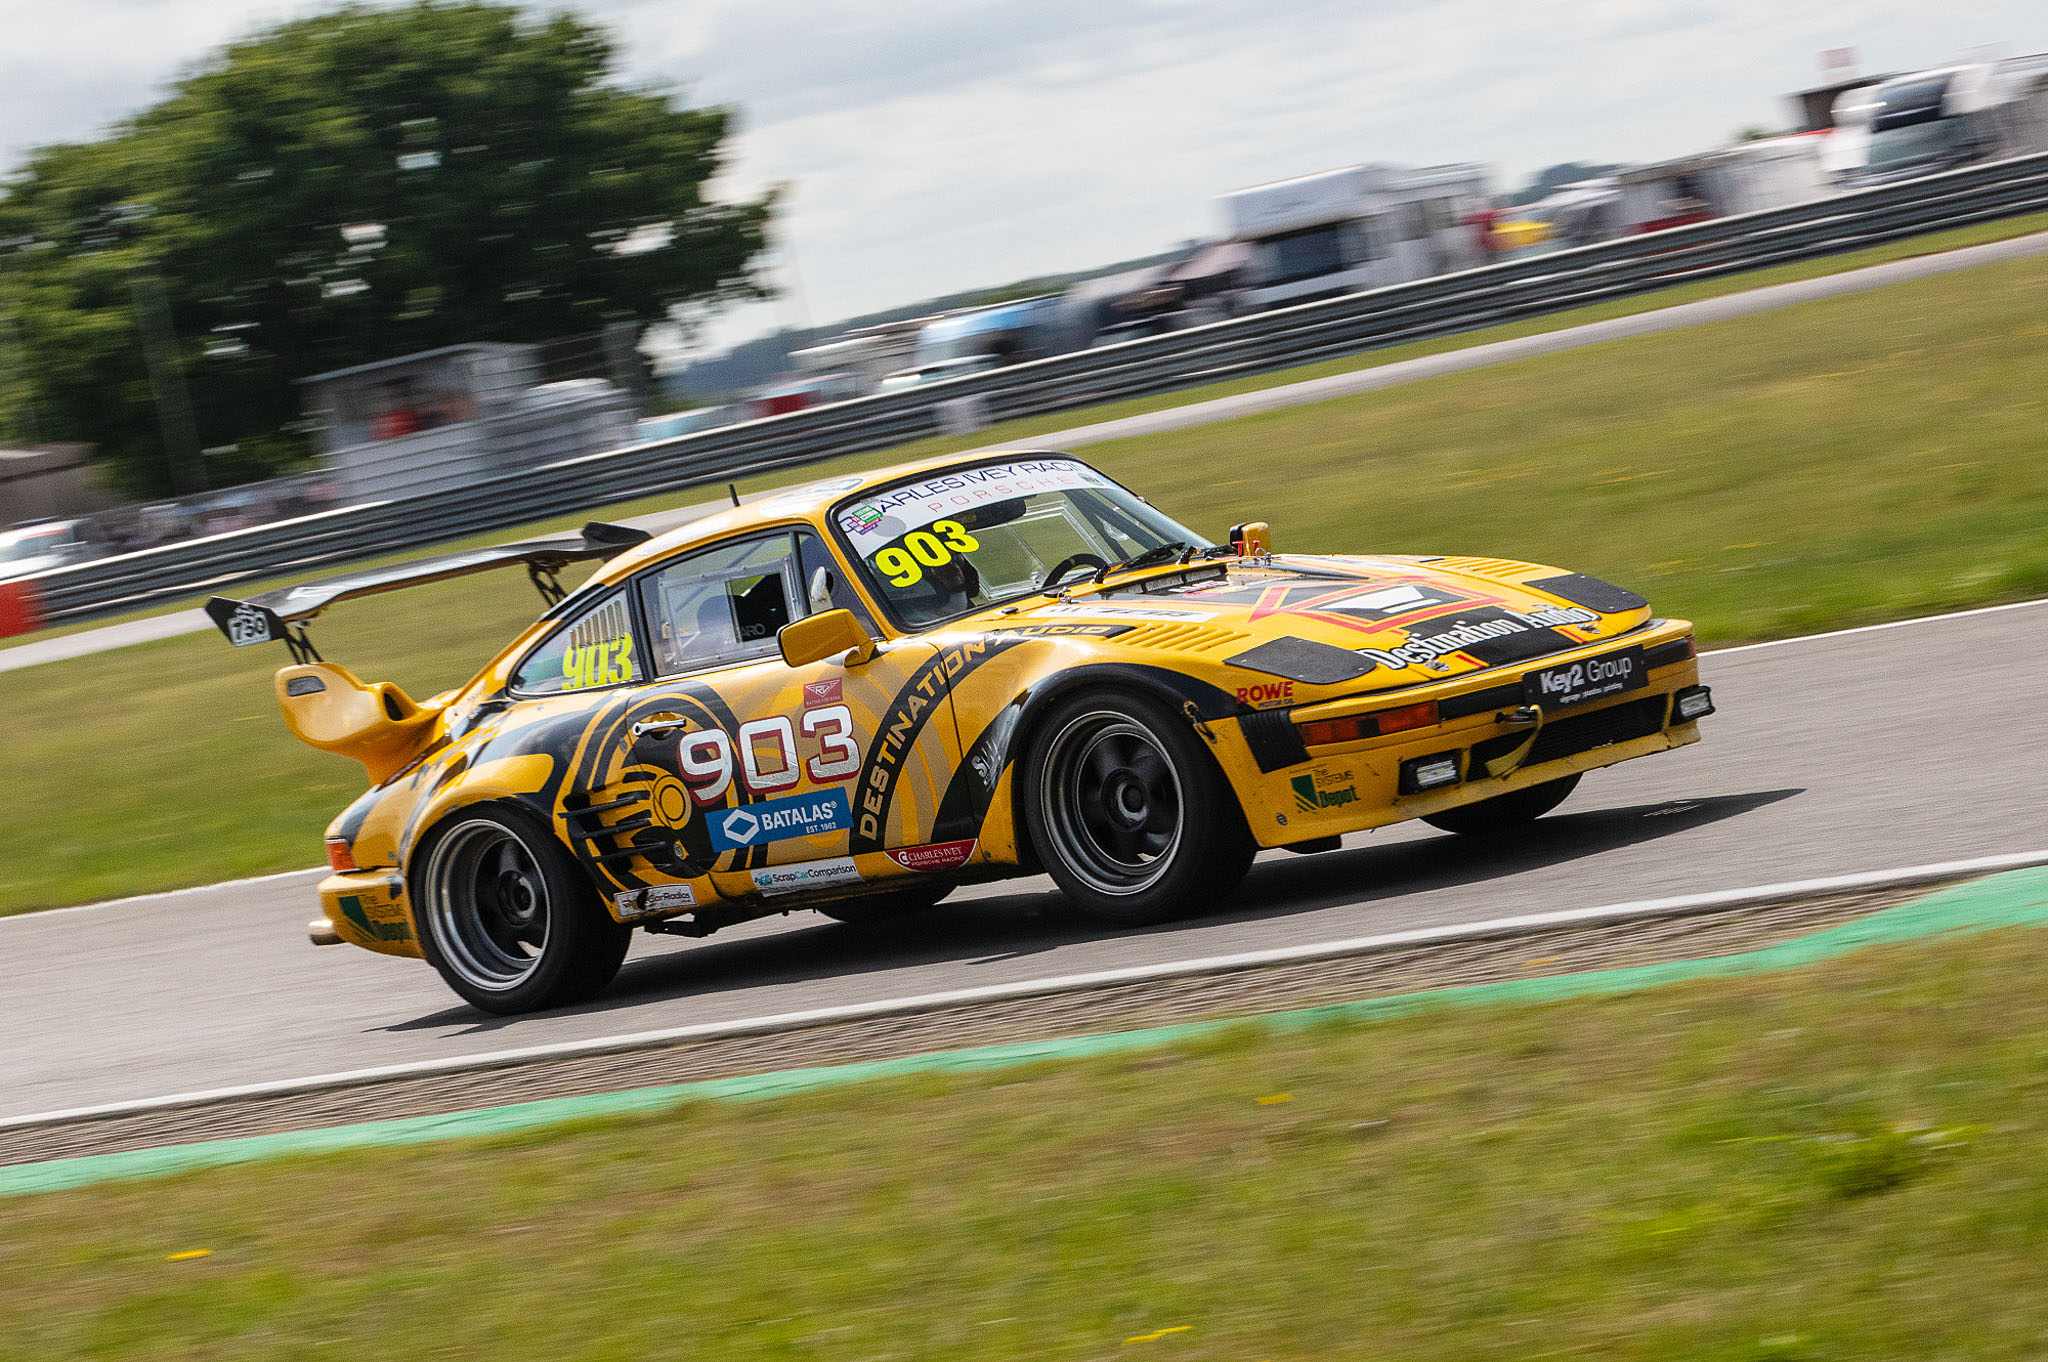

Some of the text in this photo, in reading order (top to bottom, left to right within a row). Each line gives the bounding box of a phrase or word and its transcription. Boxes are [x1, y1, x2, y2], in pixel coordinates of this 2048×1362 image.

[839, 477, 966, 533] CARLES
[962, 466, 1017, 484] IVEY
[927, 475, 1075, 513] PORSCHE
[875, 519, 980, 588] 903
[562, 632, 634, 690] 903
[1354, 604, 1601, 671] Destination Audio
[1236, 680, 1294, 705] ROWE
[1539, 664, 1585, 694] Key2
[1586, 657, 1633, 679] Group
[679, 703, 862, 807] 903
[859, 636, 987, 841] DESTINATION
[994, 625, 1112, 646] AUDIO
[1318, 785, 1361, 809] Depot
[772, 864, 856, 883] ScrapCarComparison
[907, 846, 962, 861] CHARLES IVEY
